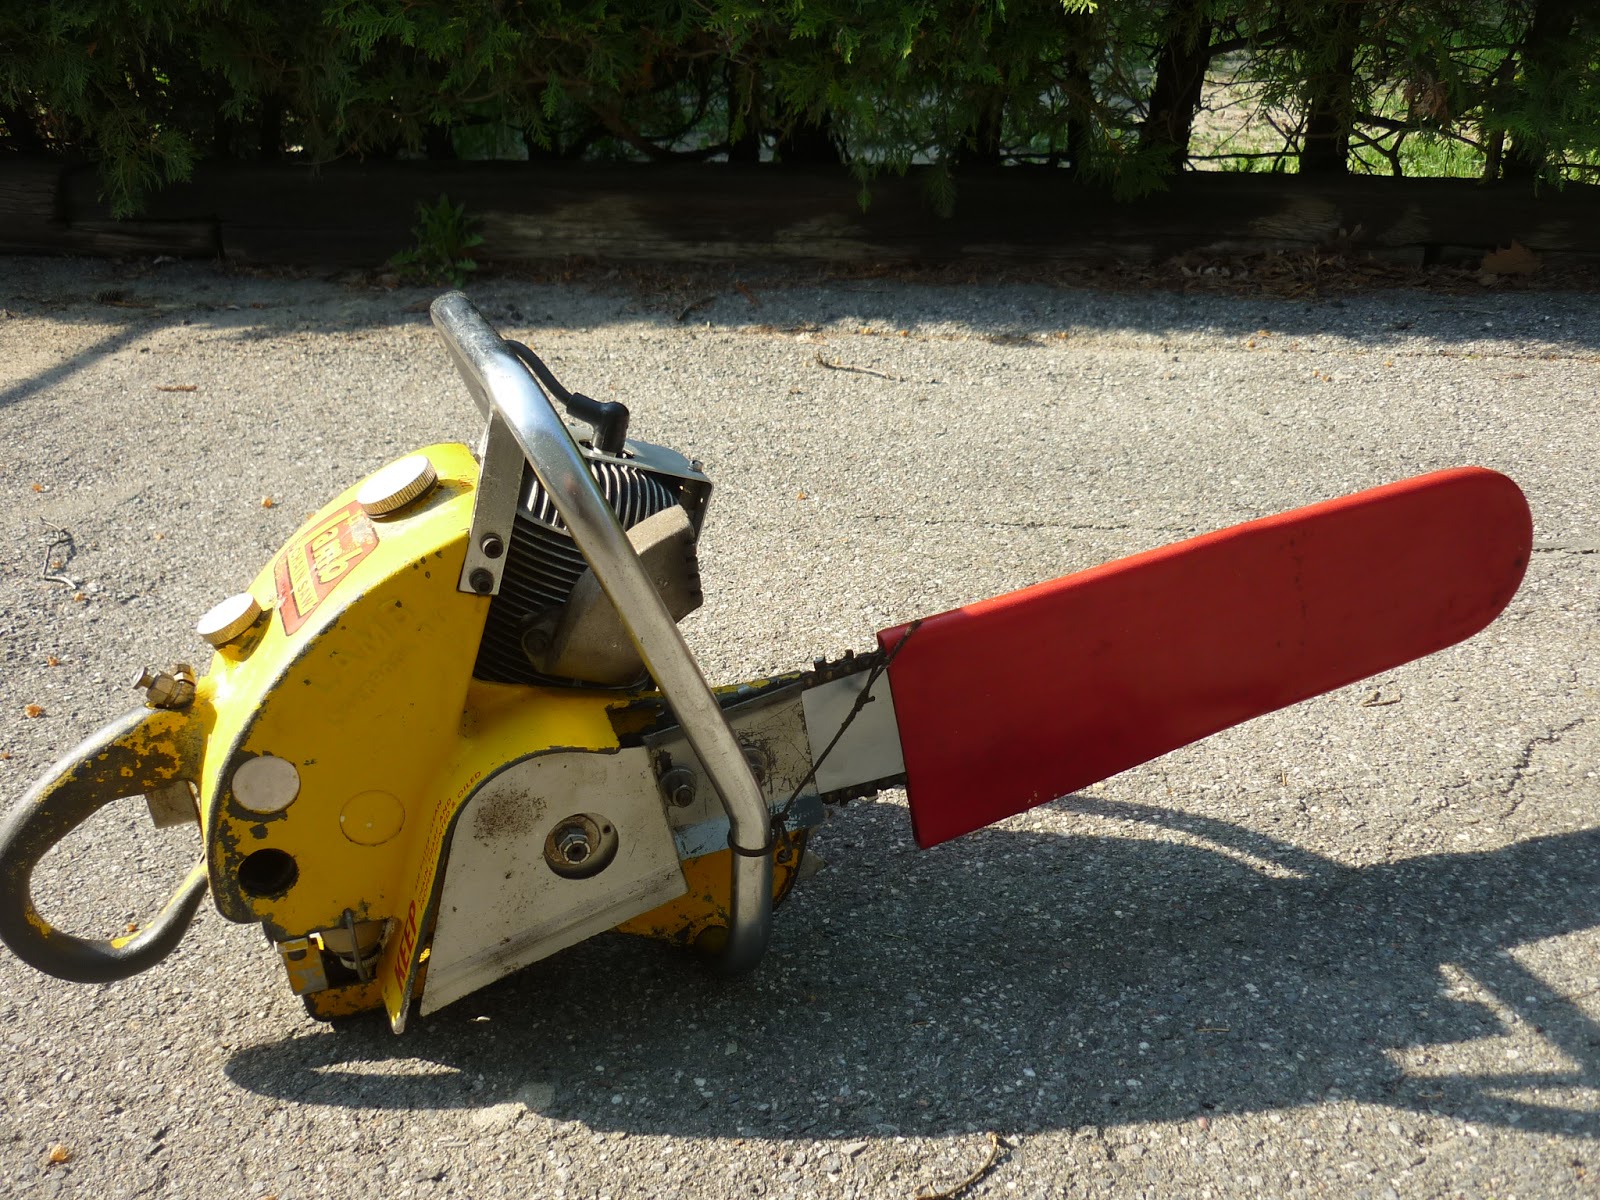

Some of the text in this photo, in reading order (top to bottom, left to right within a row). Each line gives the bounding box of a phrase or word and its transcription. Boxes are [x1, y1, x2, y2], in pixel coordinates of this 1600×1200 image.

[287, 546, 317, 609] CHAIN SAW
[457, 771, 481, 799] OILED
[439, 798, 452, 823] AND
[394, 899, 417, 995] KEEP
